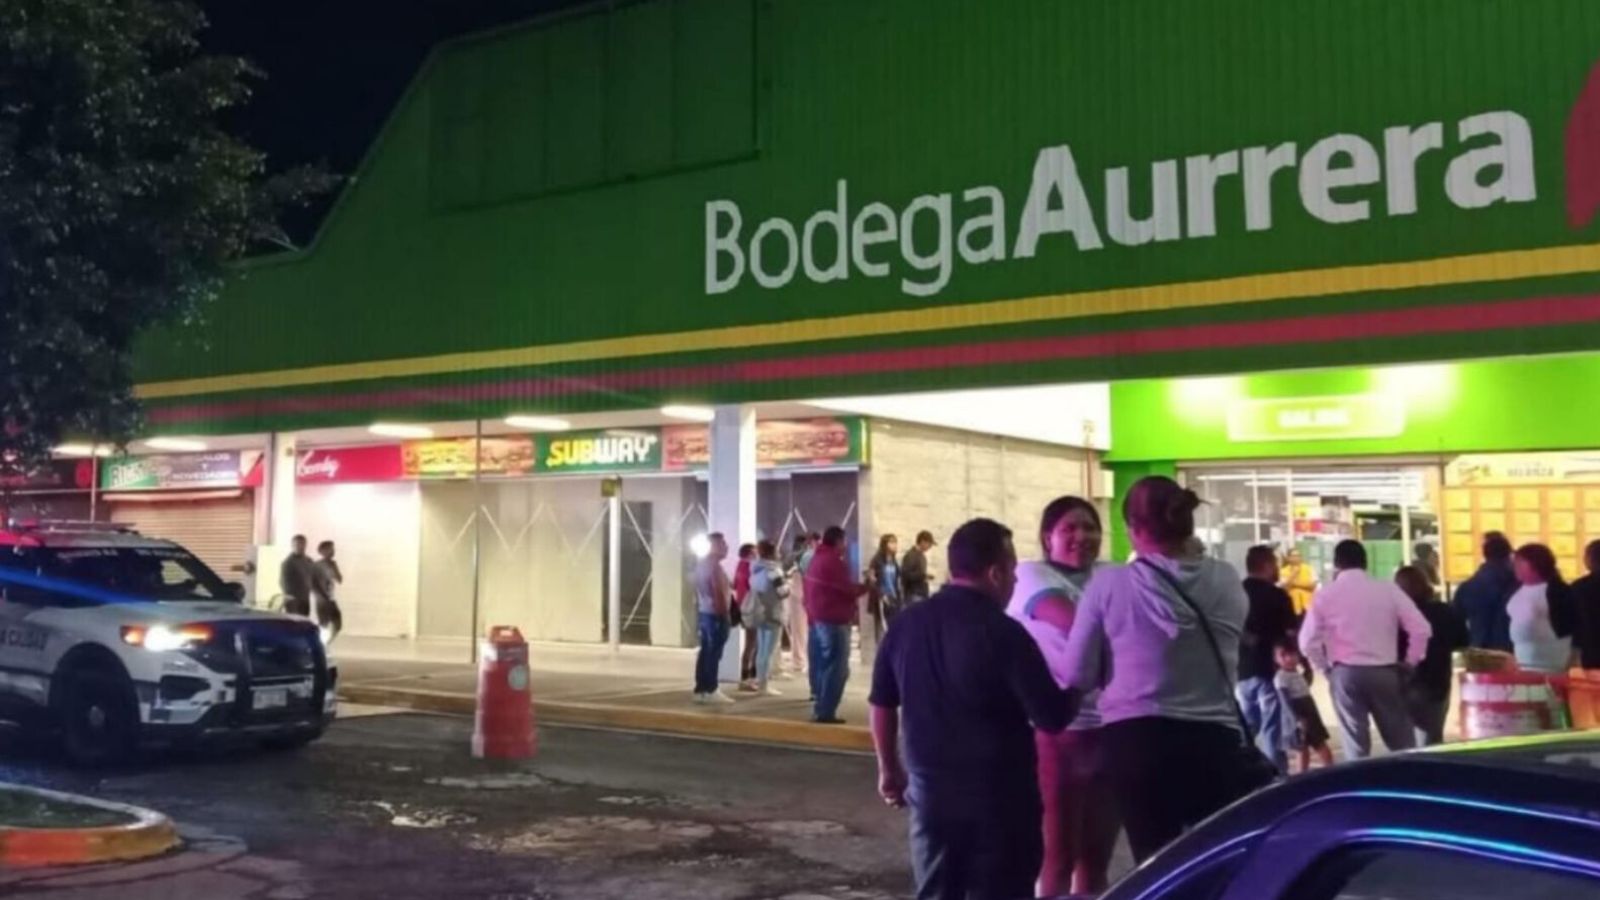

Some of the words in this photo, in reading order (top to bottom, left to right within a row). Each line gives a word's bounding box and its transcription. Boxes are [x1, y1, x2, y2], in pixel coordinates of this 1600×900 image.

[705, 179, 1006, 297] Bodega
[1013, 110, 1536, 259] Aurrera
[546, 436, 650, 466] SUBWAY
